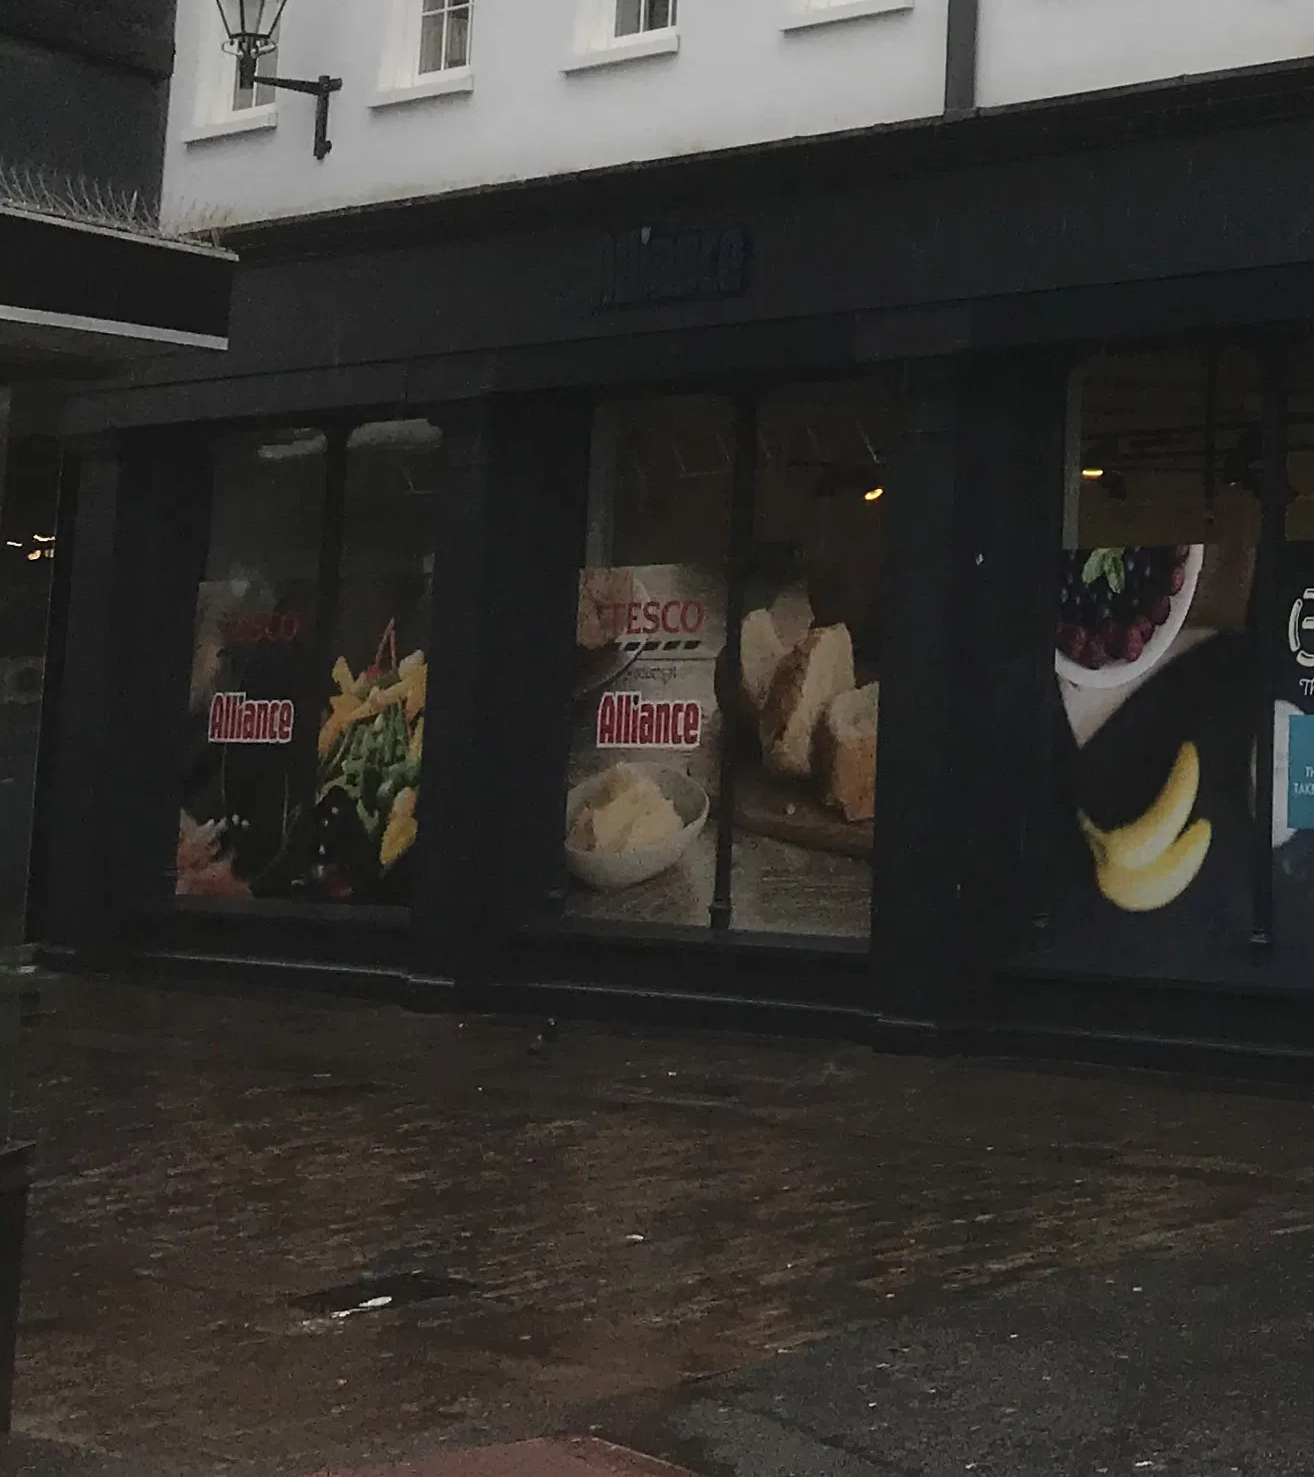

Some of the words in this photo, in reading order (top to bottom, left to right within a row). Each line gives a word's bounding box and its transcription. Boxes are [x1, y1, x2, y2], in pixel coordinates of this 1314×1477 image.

[603, 600, 704, 635] TESCO
[209, 692, 294, 743] Alliance
[597, 691, 702, 748] Alliance
